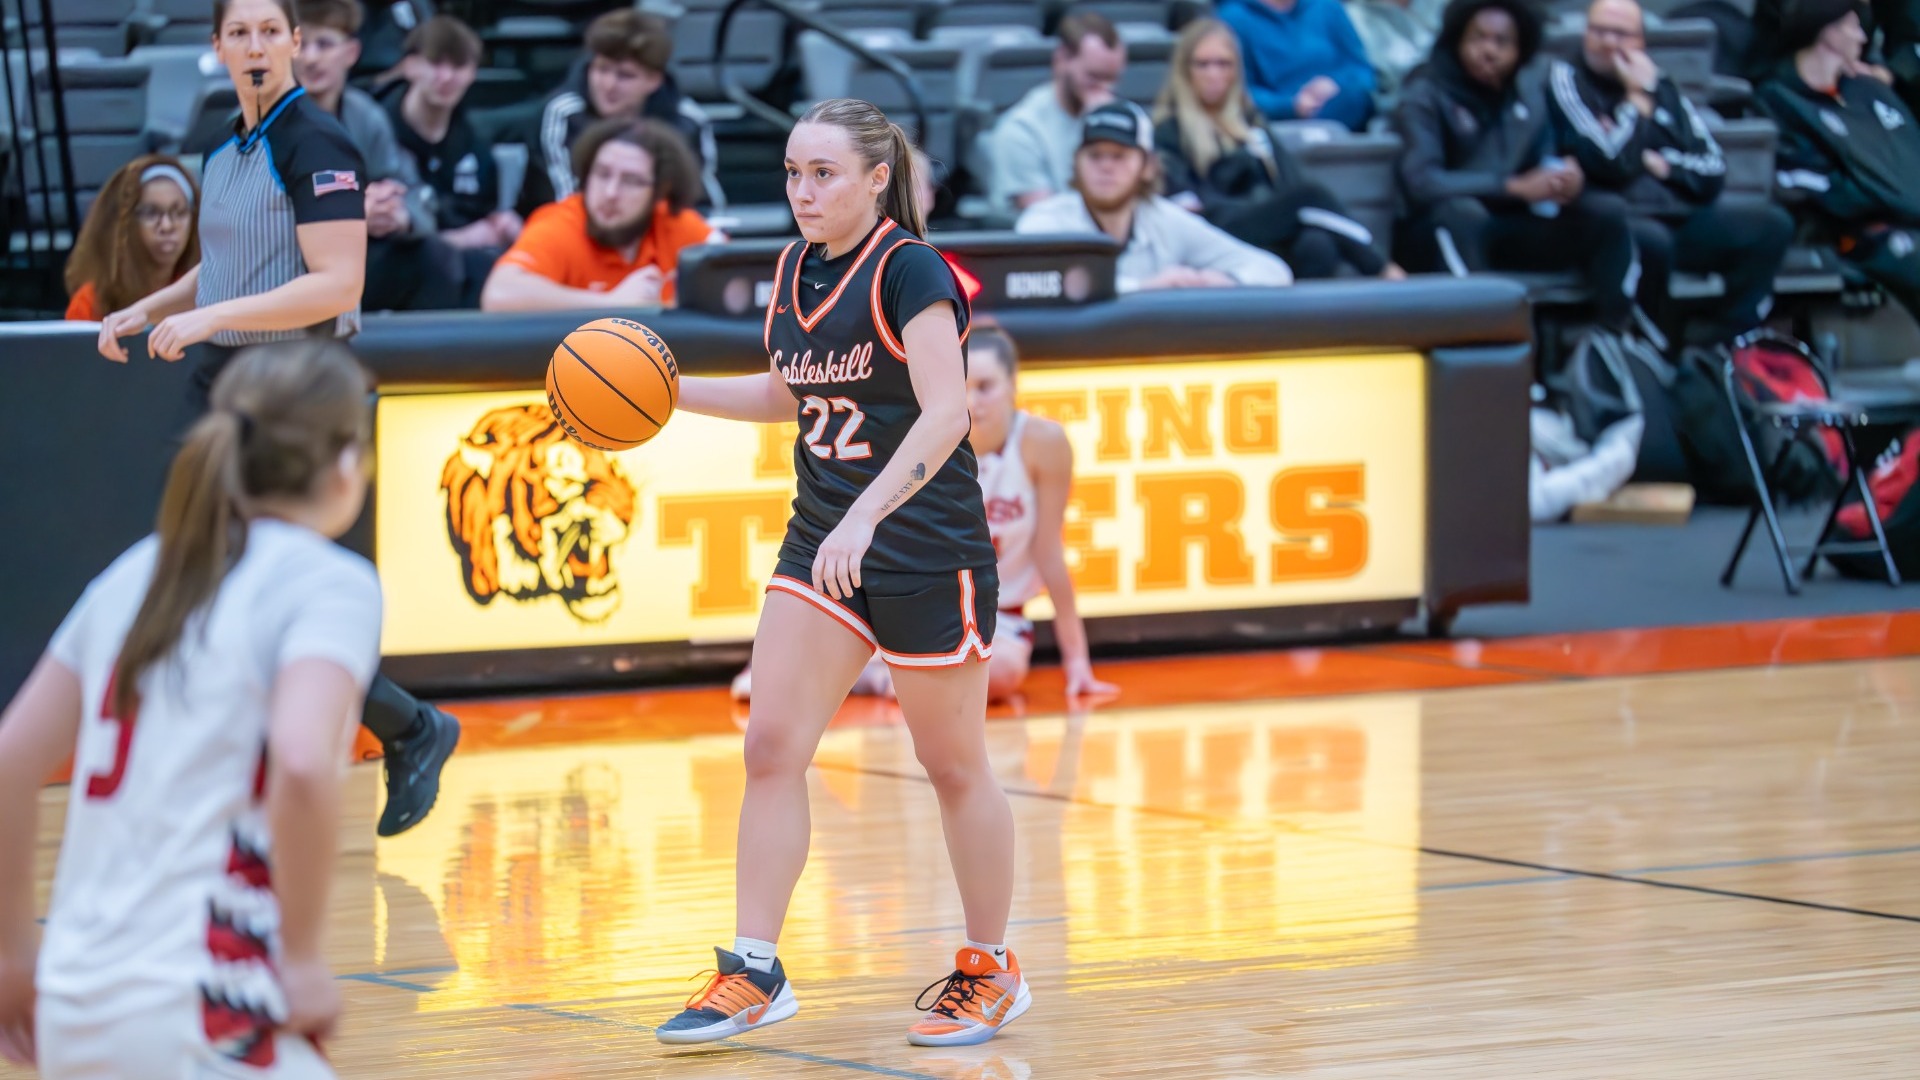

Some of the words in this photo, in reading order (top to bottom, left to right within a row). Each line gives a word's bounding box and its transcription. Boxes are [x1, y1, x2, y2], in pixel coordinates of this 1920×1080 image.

[611, 318, 677, 382] Wilson
[801, 394, 873, 460] 22
[657, 461, 1370, 616] TERS
